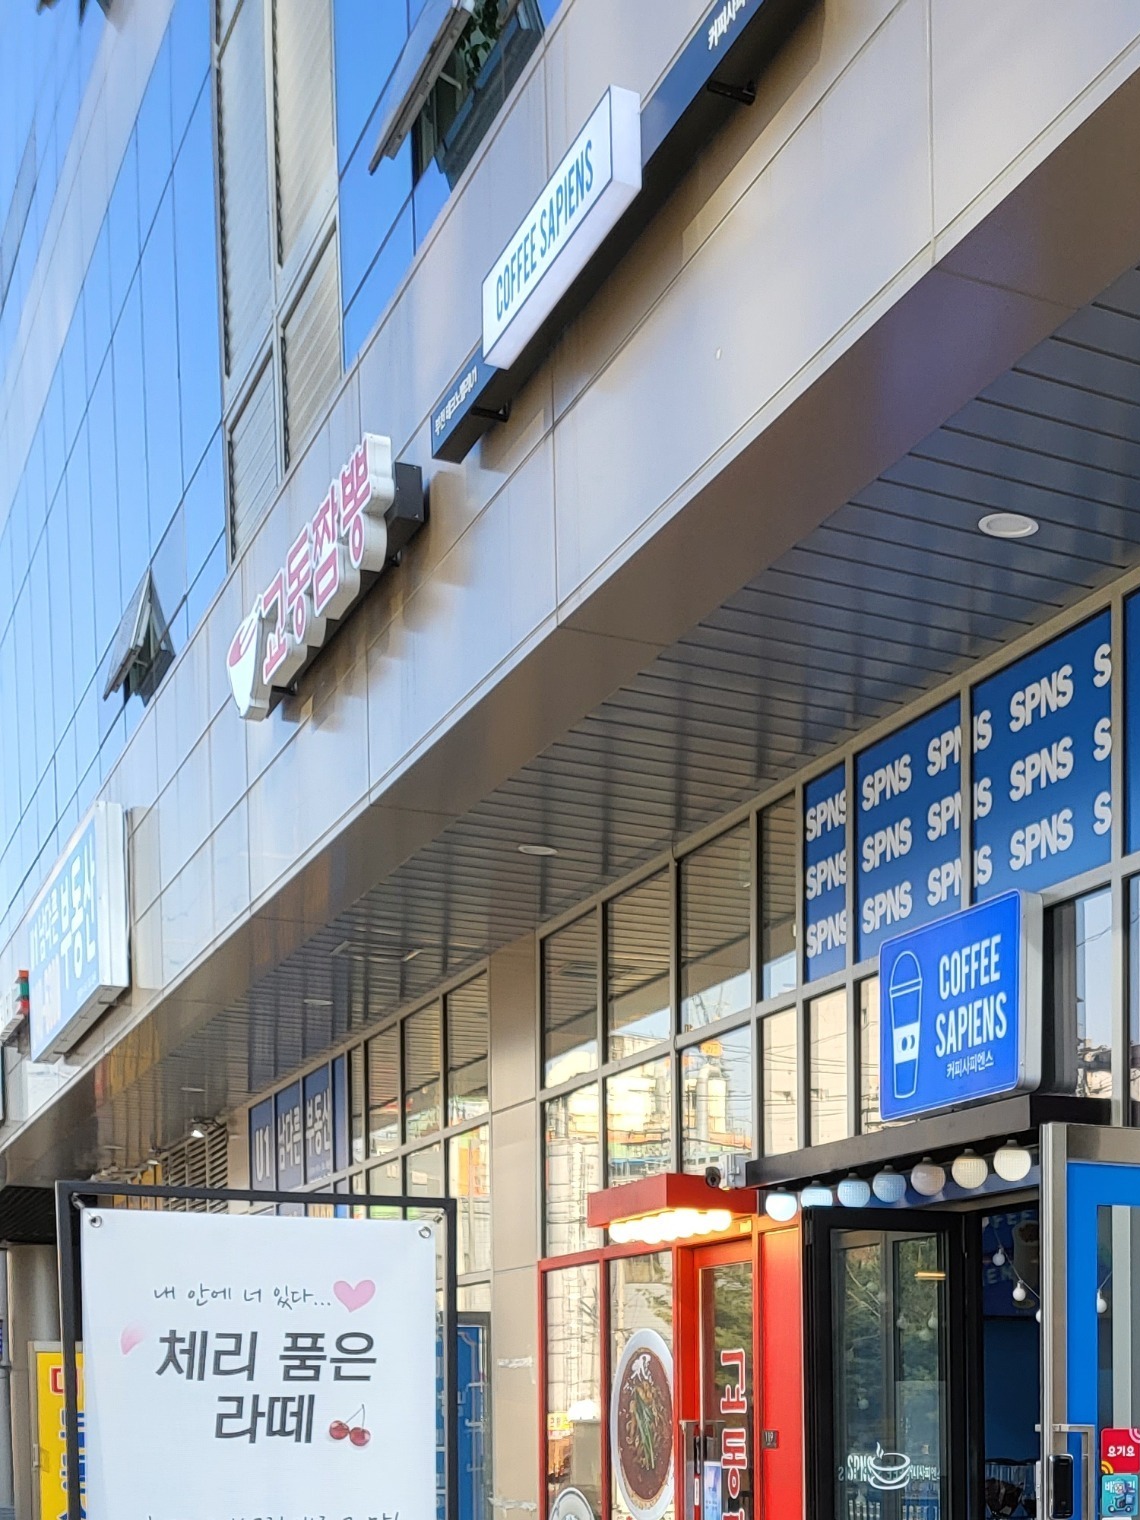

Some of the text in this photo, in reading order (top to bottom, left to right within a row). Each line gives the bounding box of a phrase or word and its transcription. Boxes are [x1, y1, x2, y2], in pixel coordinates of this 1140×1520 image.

[496, 139, 594, 322] COFFEE SAPIENS
[1009, 664, 1073, 732] SPNS
[862, 754, 912, 811] SPNS
[1009, 737, 1073, 801] SPNS
[862, 817, 912, 872] SPNS
[1009, 809, 1073, 871] SPNS
[60, 833, 96, 990] 부동산
[862, 880, 912, 934] SPNS
[939, 933, 1002, 1000] COFFEE
[935, 991, 1007, 1058] SAPIENS
[946, 1051, 994, 1079] 커피사피엔스
[255, 1124, 272, 1182] U1
[154, 1286, 176, 1299] 내
[187, 1283, 231, 1307] 안에
[244, 1288, 262, 1303] 너
[156, 1329, 377, 1381] 체리 품은
[215, 1394, 315, 1444] 라떼
[1107, 1445, 1135, 1457] 요기요
